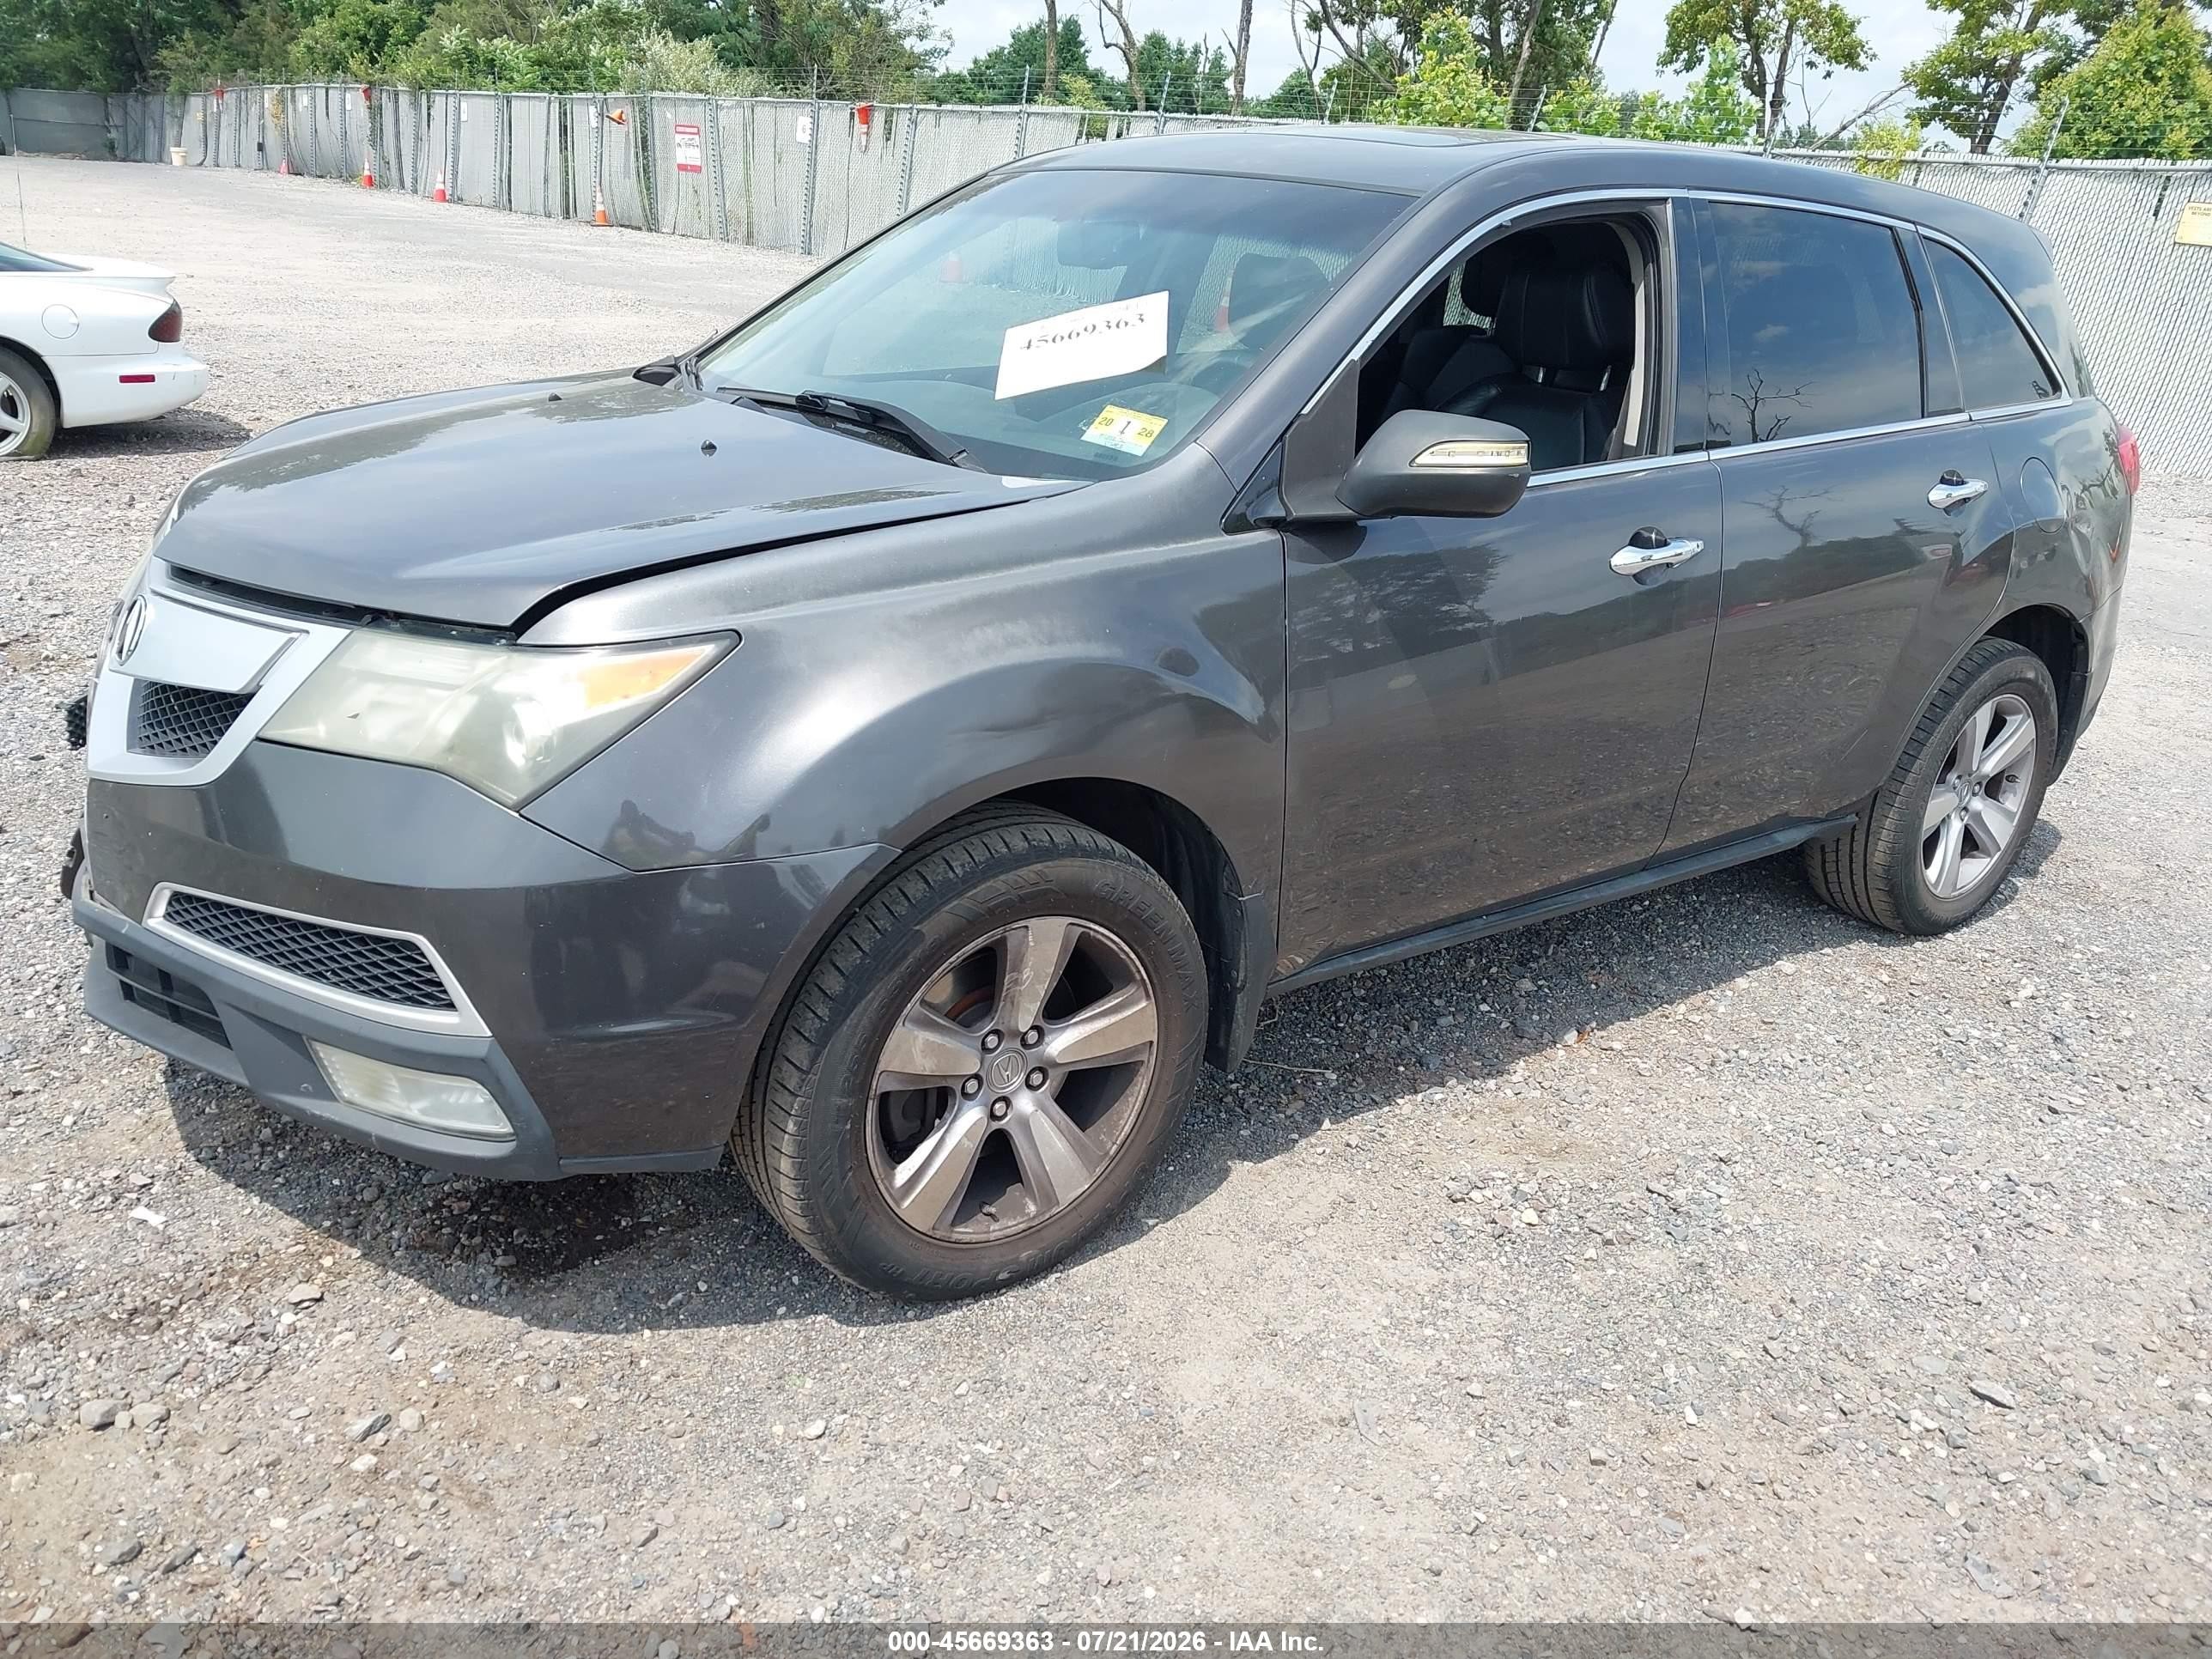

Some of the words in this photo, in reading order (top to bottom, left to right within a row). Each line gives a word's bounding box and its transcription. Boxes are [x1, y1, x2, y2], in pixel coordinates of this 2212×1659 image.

[1019, 313, 1146, 350] 45669363
[1098, 416, 1115, 427] 20
[1136, 427, 1155, 438] 28
